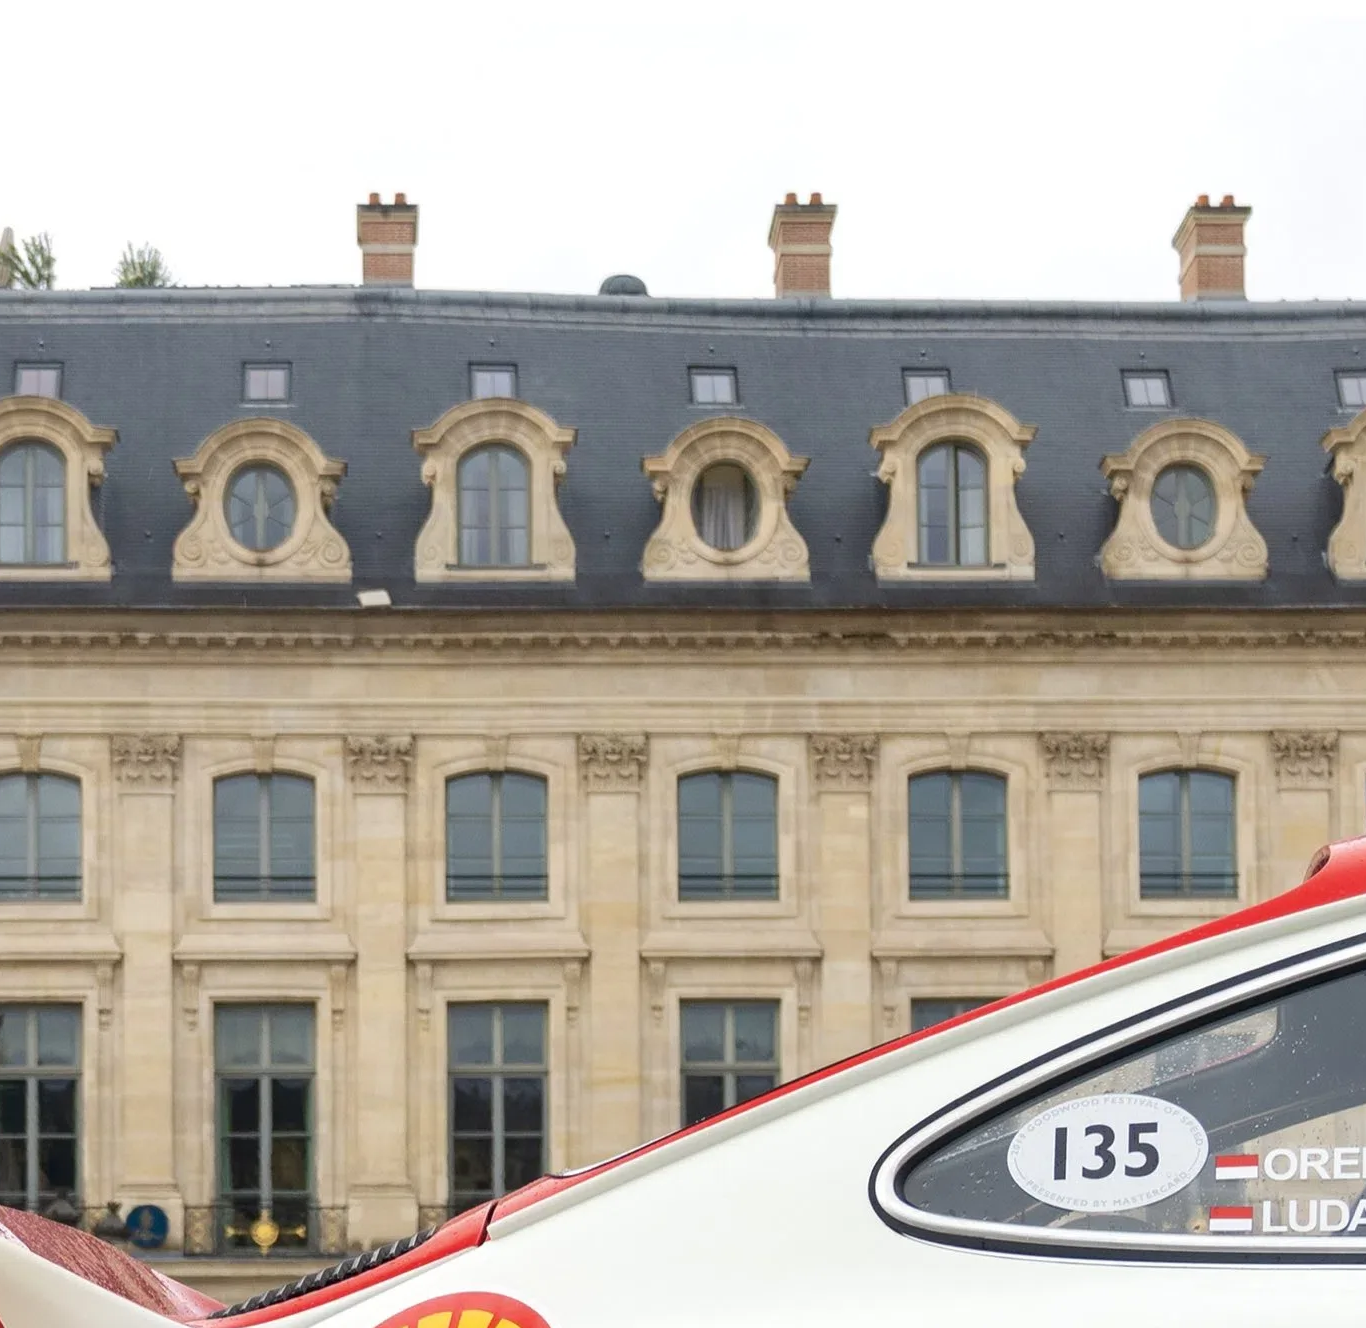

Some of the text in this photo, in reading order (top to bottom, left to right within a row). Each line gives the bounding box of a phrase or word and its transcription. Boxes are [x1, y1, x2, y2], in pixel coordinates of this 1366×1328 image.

[1027, 1098, 1099, 1131] GOODWOOD
[1104, 1096, 1159, 1110] FESTIVAL
[1164, 1106, 1180, 1118] OF
[1180, 1115, 1204, 1146] SPEED
[1053, 1122, 1160, 1180] 135
[1025, 1171, 1189, 1207] PRESENTED BY MASTERCARD
